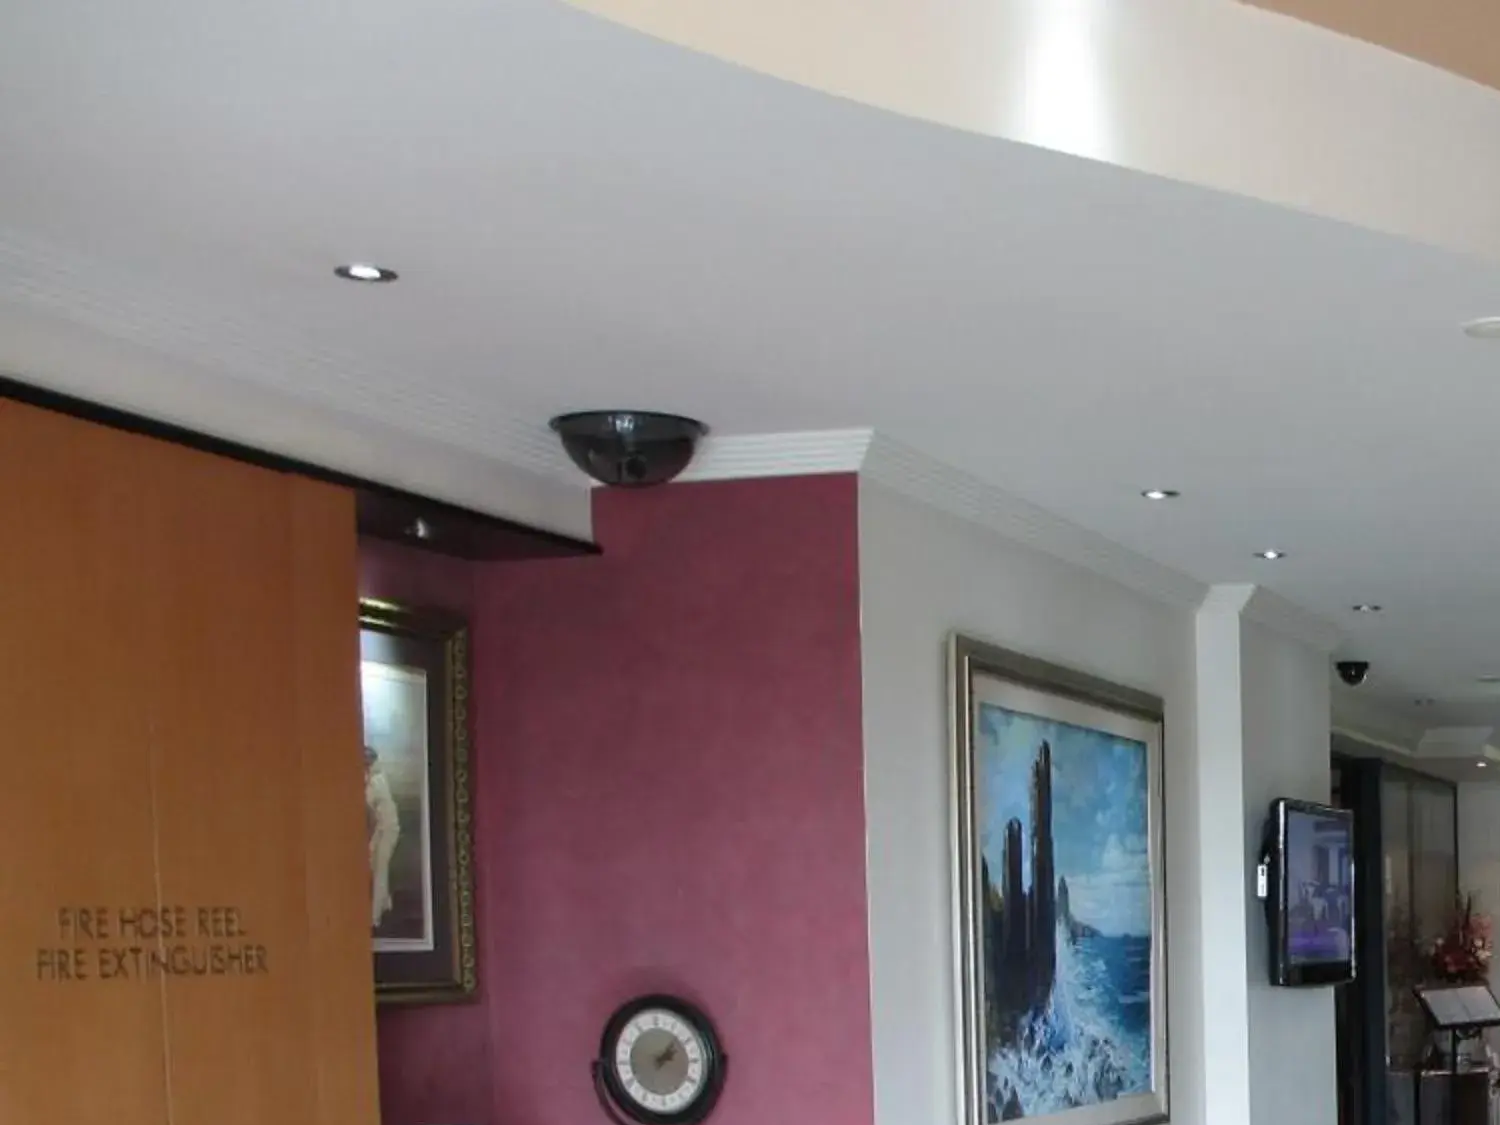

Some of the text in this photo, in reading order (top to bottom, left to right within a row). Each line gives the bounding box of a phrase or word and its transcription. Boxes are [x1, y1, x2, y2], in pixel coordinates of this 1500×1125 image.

[58, 906, 110, 940] FIRE
[118, 905, 188, 939] HOSE
[36, 944, 269, 981] FIRE EXTINGUISHER
